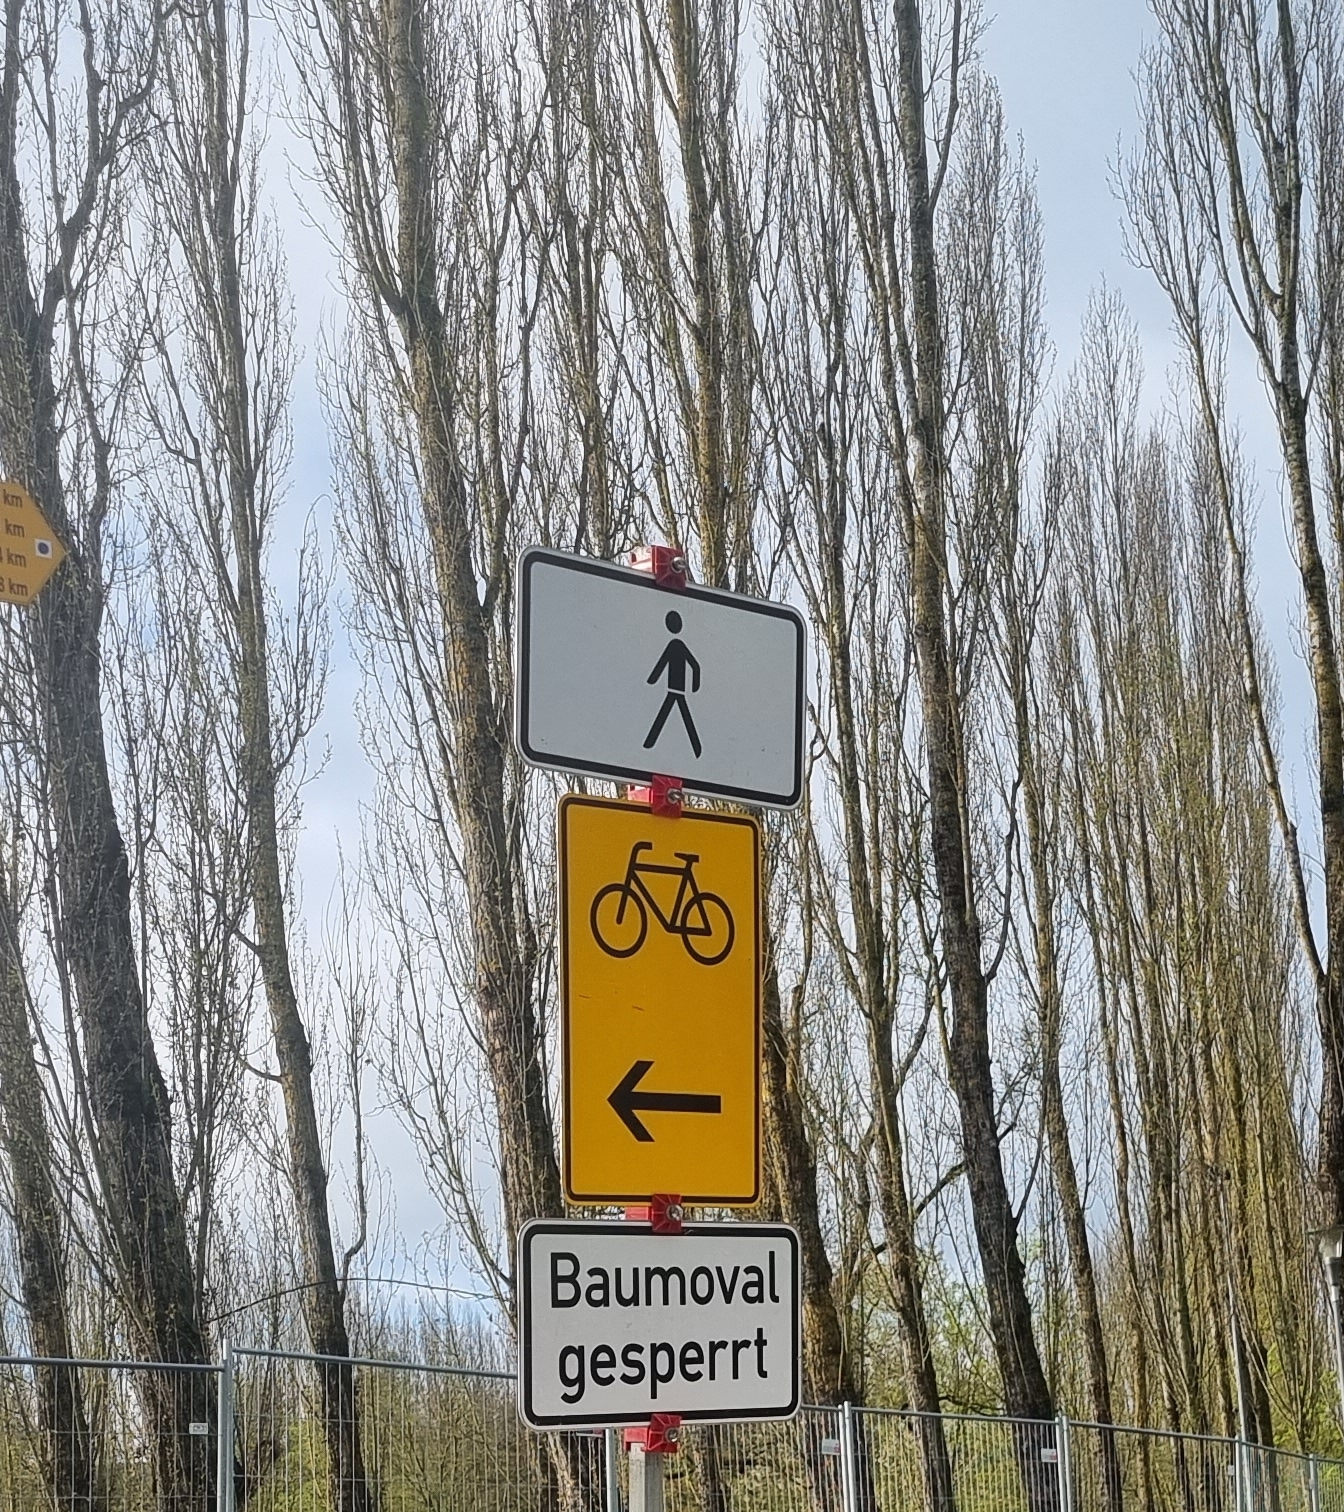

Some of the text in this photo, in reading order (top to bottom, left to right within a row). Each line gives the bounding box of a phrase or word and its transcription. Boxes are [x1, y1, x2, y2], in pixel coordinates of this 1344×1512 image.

[3, 489, 23, 508] km
[5, 519, 25, 538] km
[7, 548, 27, 568] km
[9, 578, 29, 597] km
[550, 1250, 780, 1309] Baumoval
[558, 1327, 768, 1405] gesperrt
